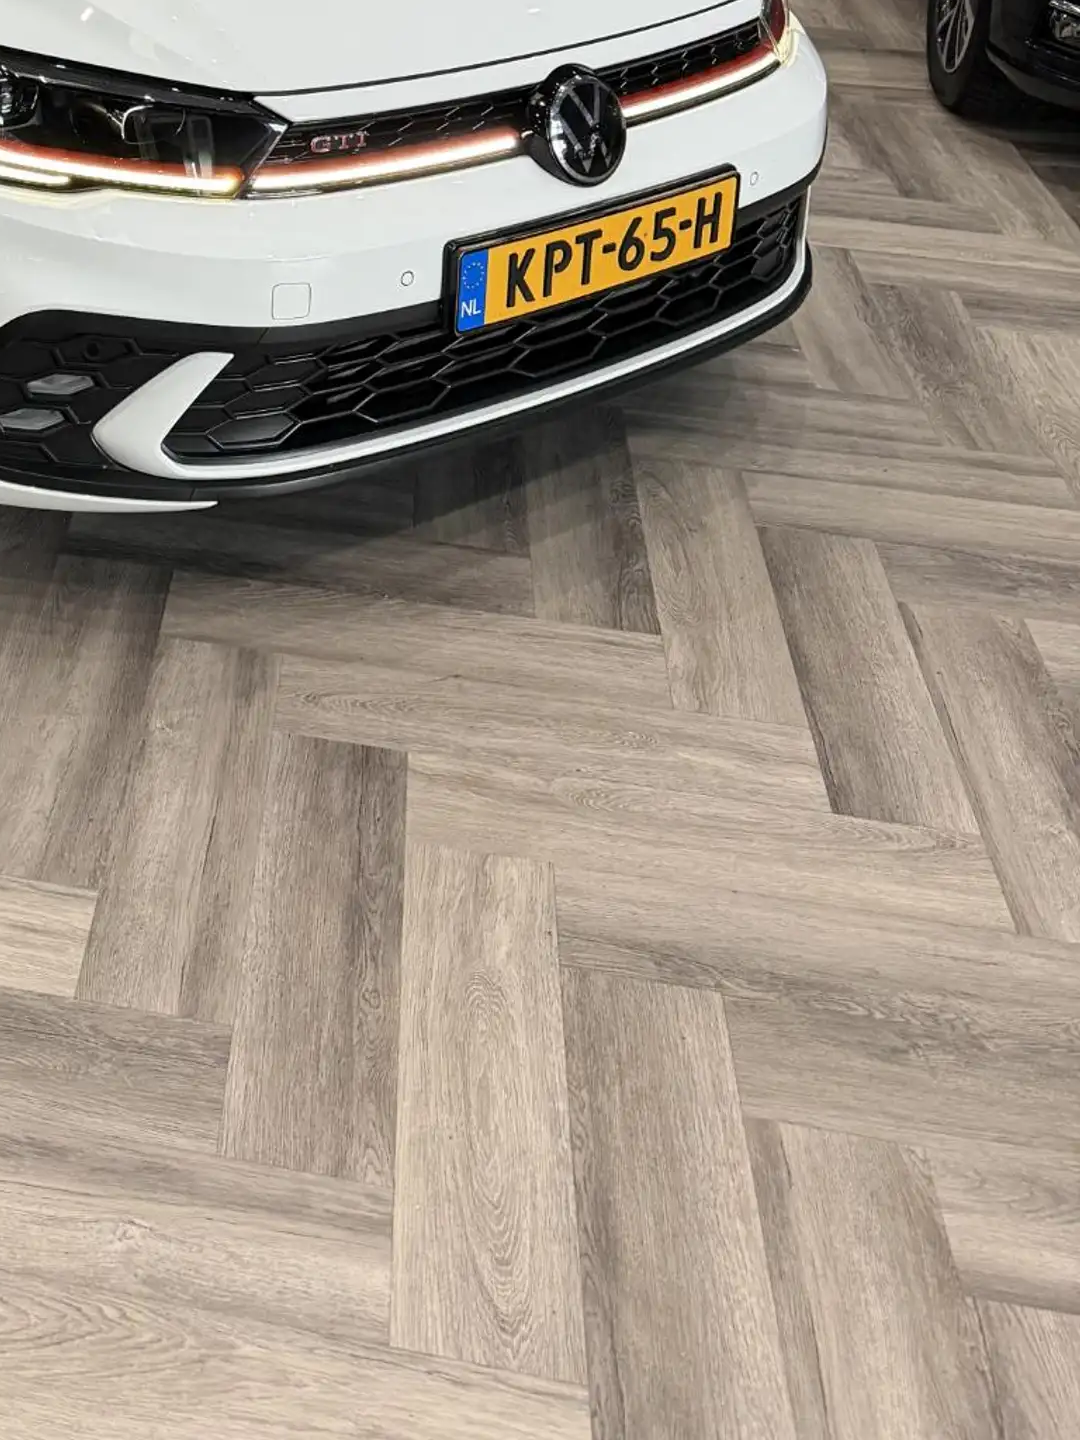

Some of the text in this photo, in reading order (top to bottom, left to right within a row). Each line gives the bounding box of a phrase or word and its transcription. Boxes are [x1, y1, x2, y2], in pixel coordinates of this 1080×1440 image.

[310, 130, 369, 153] GTI
[505, 191, 723, 308] KPT-65-H
[460, 298, 481, 318] NL
